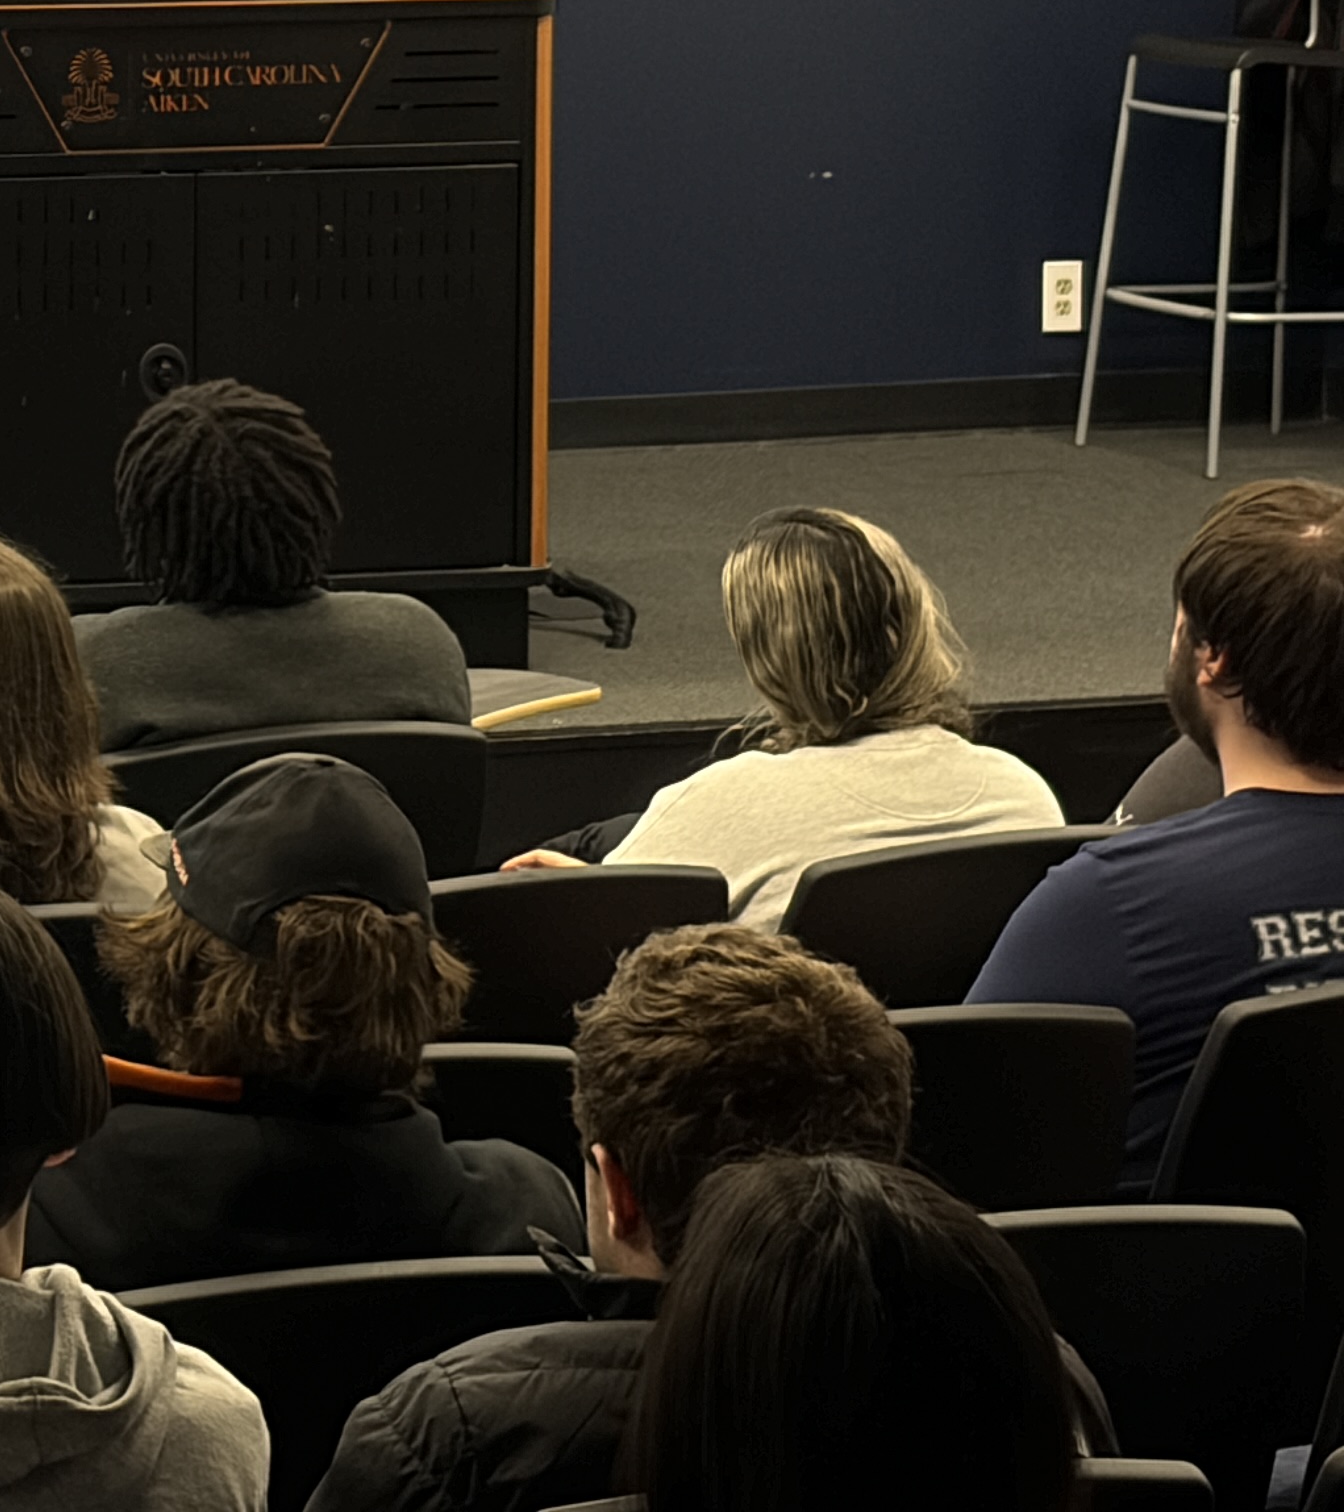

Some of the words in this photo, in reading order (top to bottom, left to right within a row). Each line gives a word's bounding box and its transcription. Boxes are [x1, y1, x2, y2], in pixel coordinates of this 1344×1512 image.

[141, 66, 220, 89] SOUTH
[223, 63, 343, 87] CAROLINA
[142, 92, 210, 114] AIKEN
